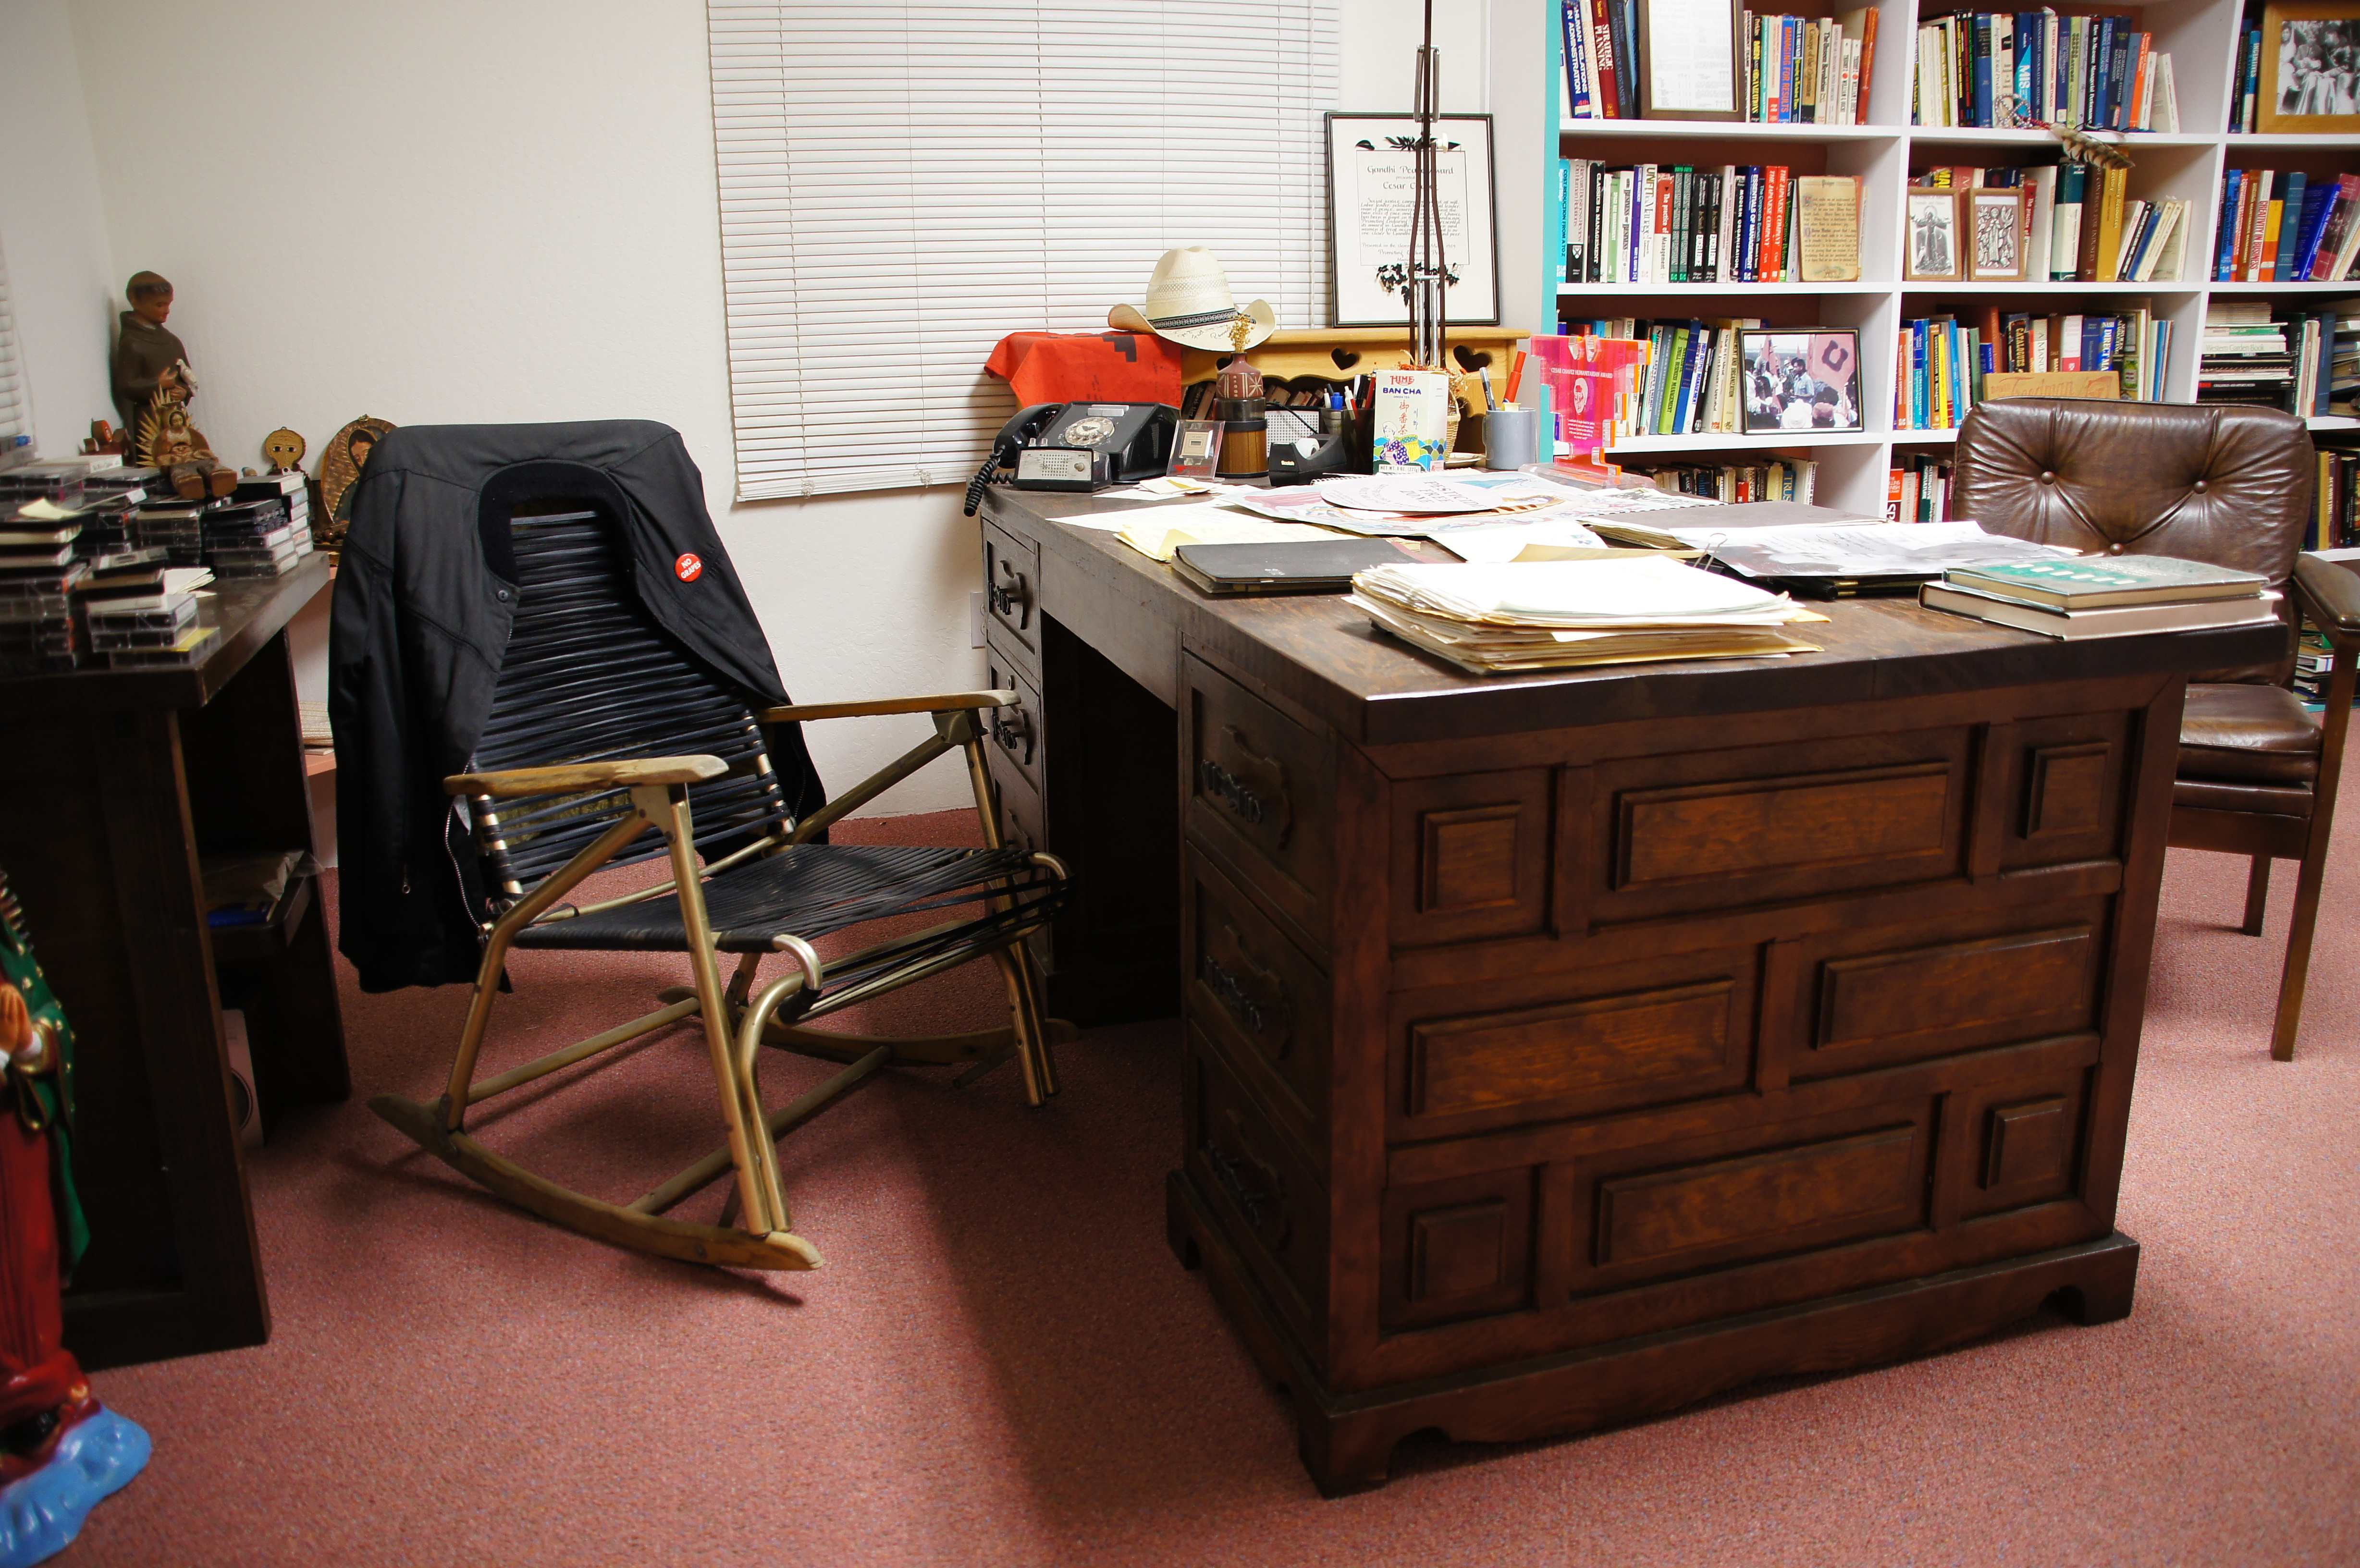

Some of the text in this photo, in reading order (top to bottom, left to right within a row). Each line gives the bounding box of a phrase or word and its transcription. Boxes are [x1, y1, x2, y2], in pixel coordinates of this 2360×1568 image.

[1567, 10, 1582, 95] IN ADMINISTRATION
[1574, 10, 1588, 94] HUMAN RELATIONS
[1595, 25, 1607, 71] PLANNING
[1602, 24, 1613, 70] STRATEGIC
[1612, 16, 1622, 57] ADVENTURES
[1618, 72, 1626, 106] BYSTANDER
[2251, 43, 2260, 78] INCENTIVES
[1782, 27, 1793, 112] MANAGING FOR RESULTS
[1820, 63, 1829, 92] Revolution
[2018, 65, 2031, 88] MIS
[2119, 49, 2127, 81] INFORMATION
[1367, 165, 1396, 175] Gandhi
[1574, 165, 1580, 176] On
[1645, 167, 1656, 197] UNFIT
[1383, 182, 1406, 190] Cesar
[1766, 184, 1775, 215] JAPANESE
[1777, 183, 1786, 214] JAPANESE
[1747, 174, 1758, 270] ESSENTIALS OF MANAGEMENT
[1764, 216, 1772, 247] COMPANY
[1774, 215, 1783, 246] COMPANY
[2255, 200, 2269, 233] CREATIVITY
[1695, 234, 1704, 267] EXCELLENCE
[1708, 234, 1717, 267] EXCELLENCE
[1734, 219, 1742, 269] ORGANIZATION
[2250, 242, 2262, 270] BUSINESS
[1654, 330, 1662, 355] Simon
[2016, 328, 2027, 367] CATALOGUES
[2103, 329, 2113, 357] DIRECT
[2206, 343, 2264, 352] Western Garden Book
[1389, 375, 1415, 385] HIME
[1672, 361, 1681, 381] BUSINESS
[1728, 367, 1737, 398] ORGANIZATION
[1667, 382, 1677, 413] MANAGEMENT
[1692, 373, 1702, 405] MANAGEMENT
[1399, 490, 1435, 503] ZONE
[1419, 489, 1454, 503] FREE
[1423, 481, 1487, 508] PESTICIDE
[1782, 474, 1793, 502] TRUS
[680, 561, 701, 579] GRAPES
[681, 558, 692, 569] NO
